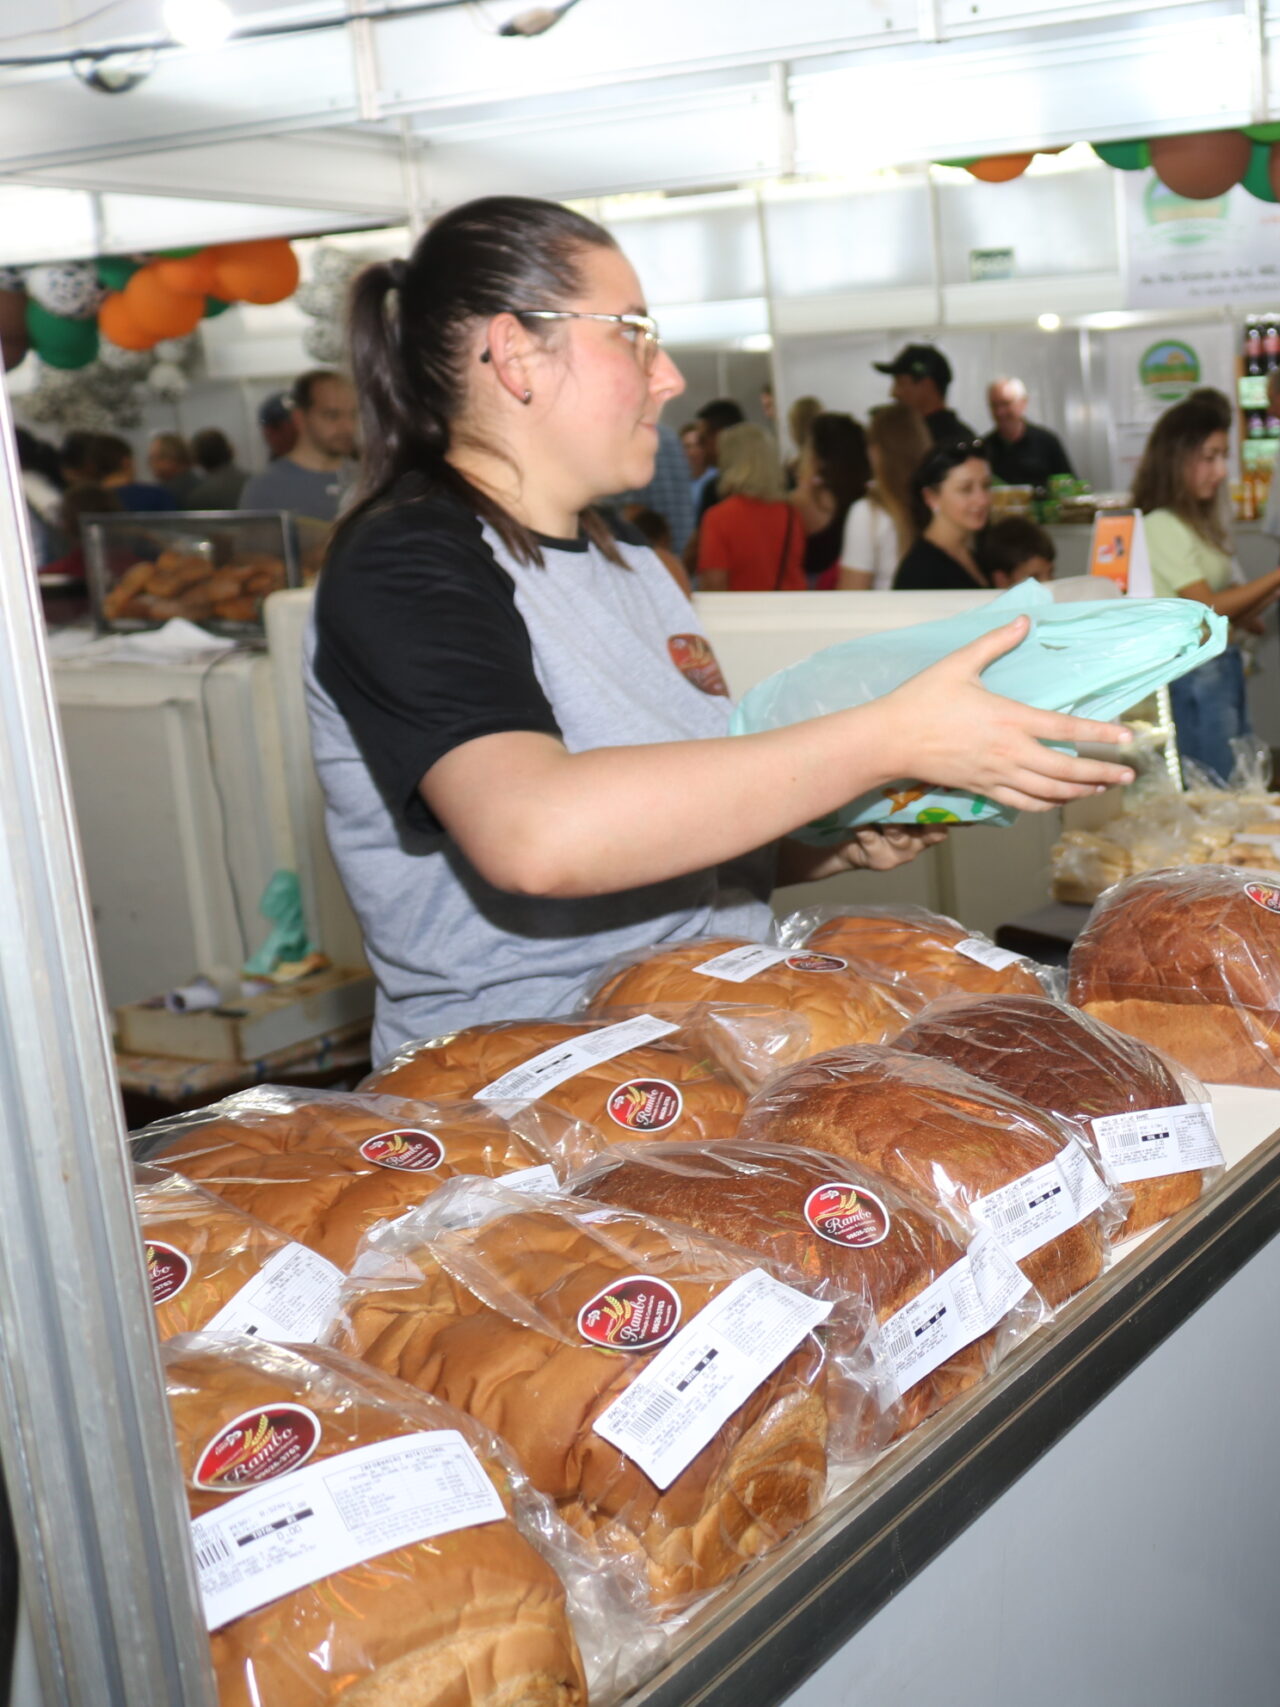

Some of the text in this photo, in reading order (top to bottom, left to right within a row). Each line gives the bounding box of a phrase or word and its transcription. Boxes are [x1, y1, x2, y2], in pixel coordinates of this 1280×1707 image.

[636, 1089, 658, 1125] Rambo
[825, 1209, 872, 1233] Rambo
[620, 1293, 646, 1342] Rambo
[224, 1428, 293, 1484] Rambo
